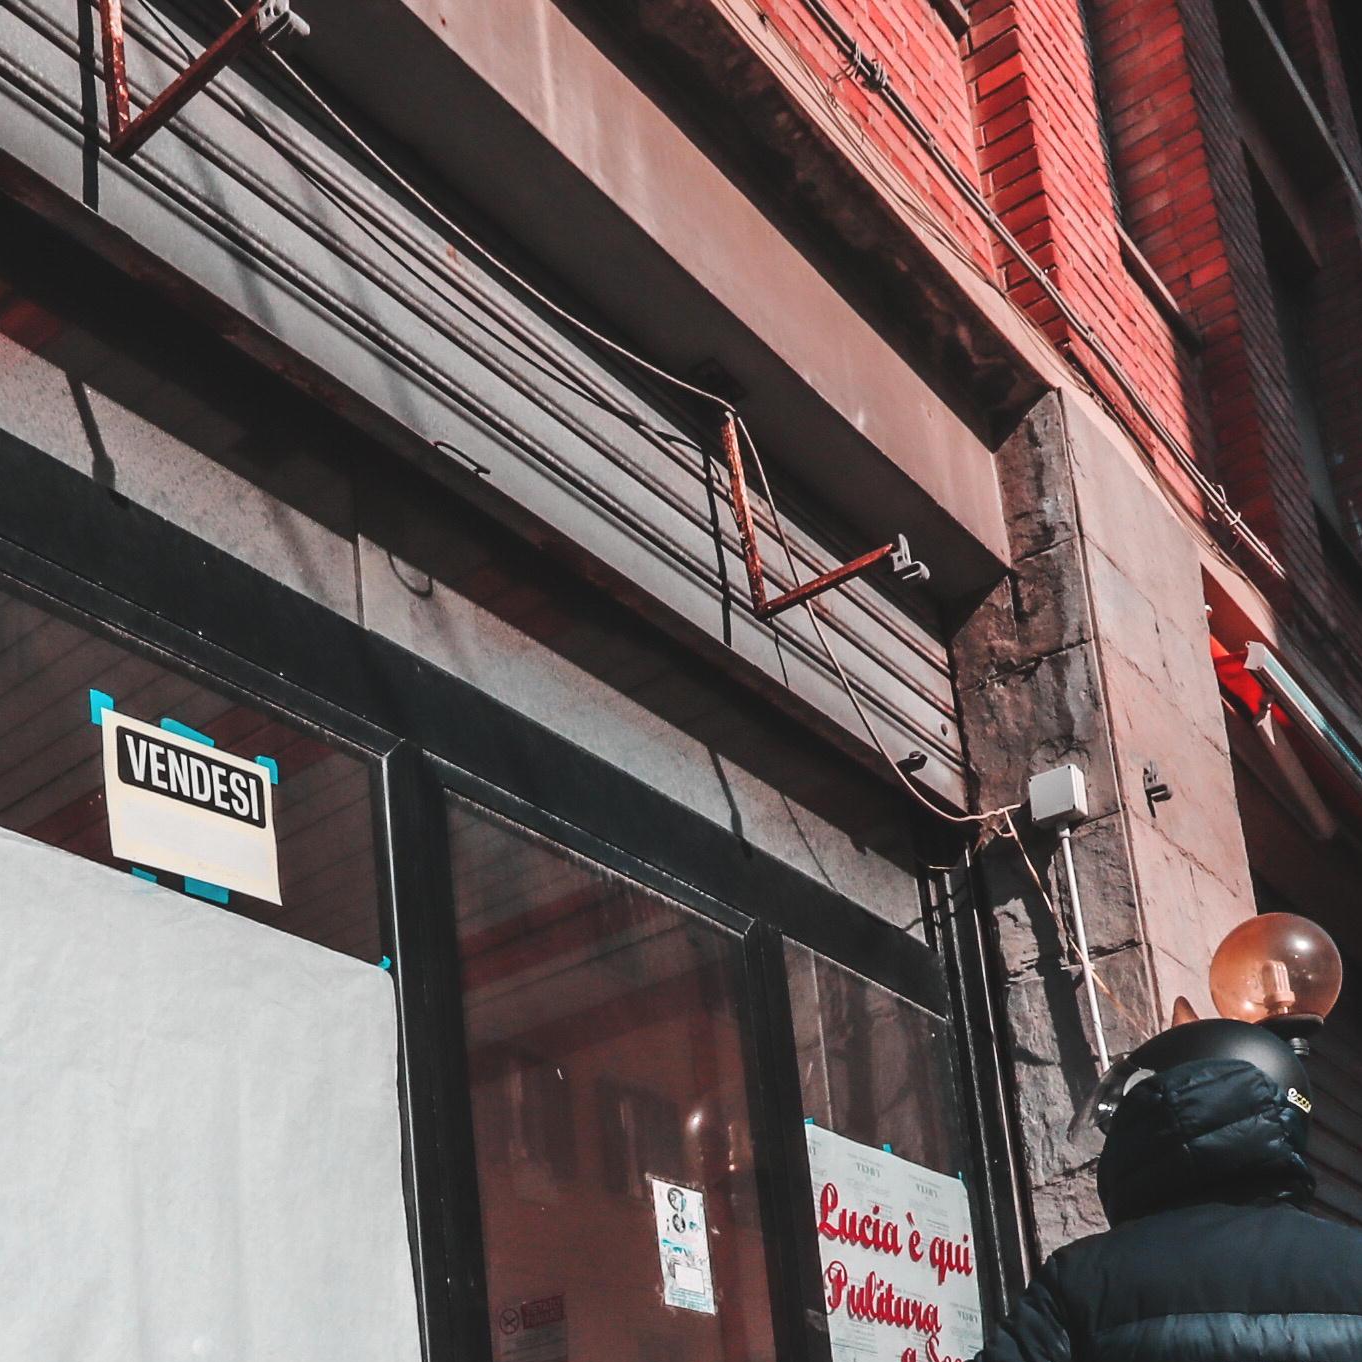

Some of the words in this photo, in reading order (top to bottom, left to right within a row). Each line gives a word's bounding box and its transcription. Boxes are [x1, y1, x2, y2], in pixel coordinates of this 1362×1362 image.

[124, 733, 260, 821] VENDESI
[819, 1183, 903, 1254] Lucia
[906, 1213, 924, 1261] è
[930, 1235, 973, 1285] qui
[826, 1261, 942, 1334] Pulitura
